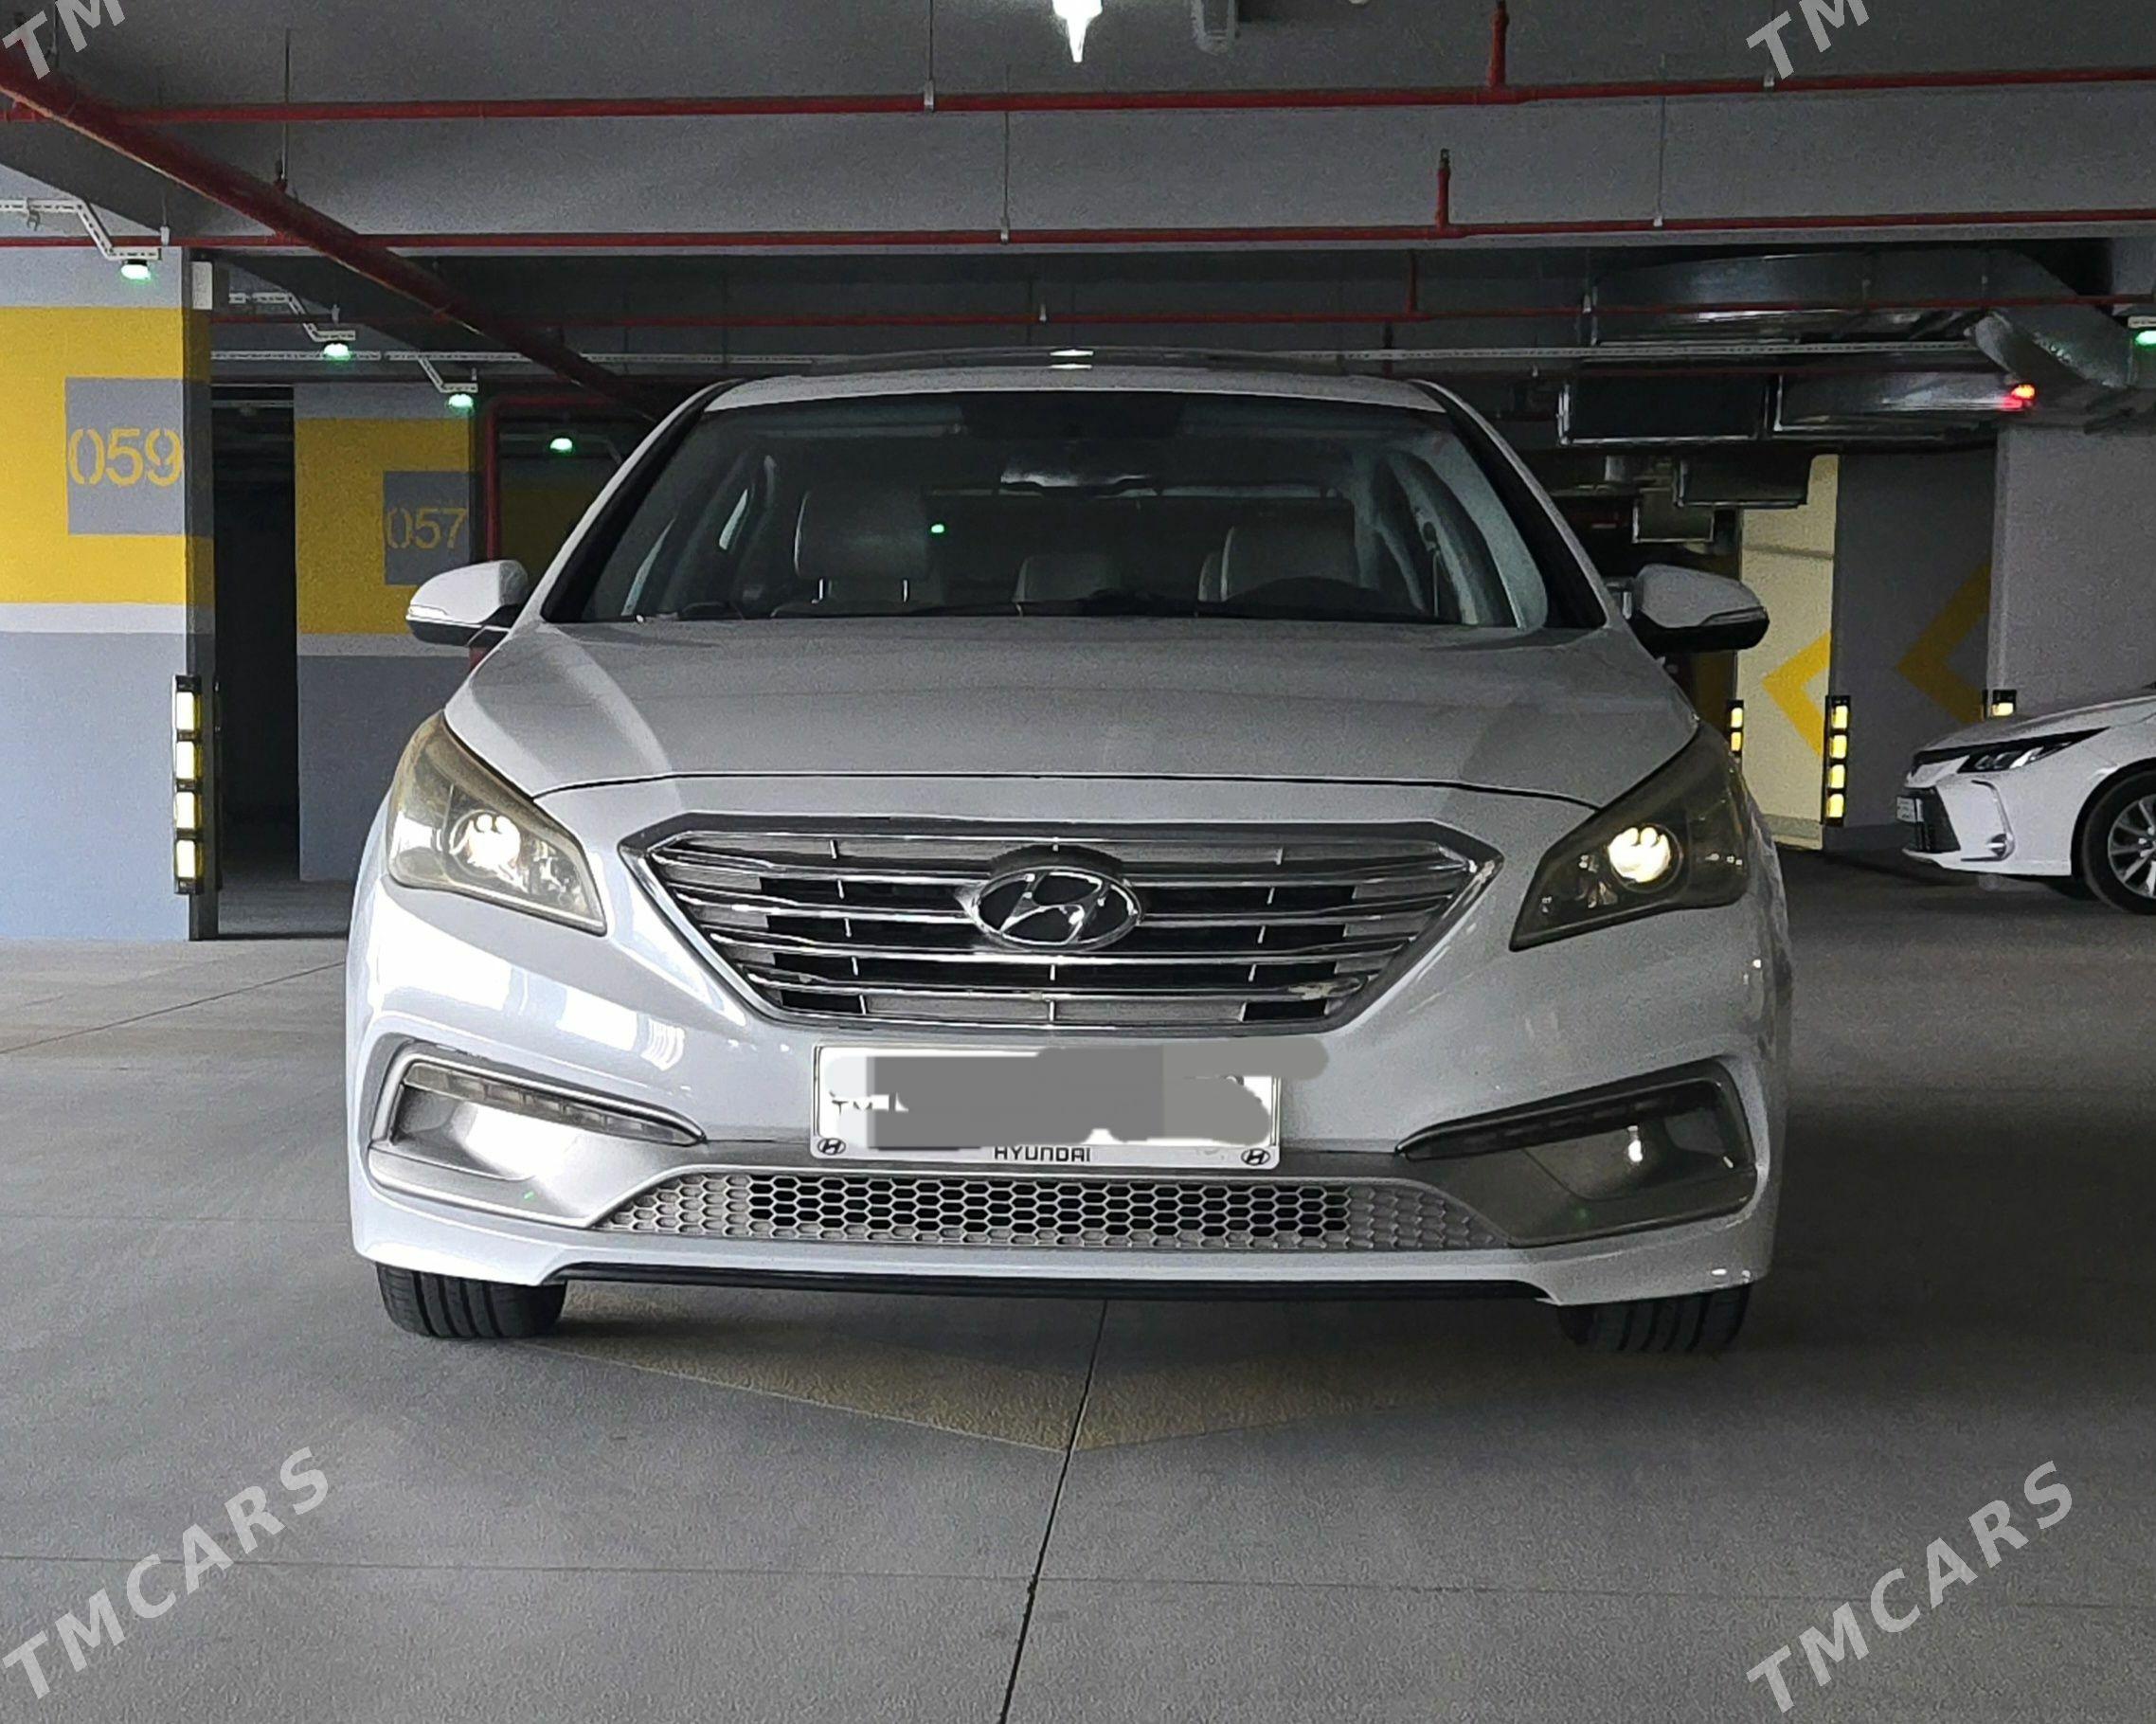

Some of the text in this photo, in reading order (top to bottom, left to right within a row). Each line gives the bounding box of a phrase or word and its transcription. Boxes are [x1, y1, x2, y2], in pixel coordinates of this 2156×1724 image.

[67, 428, 182, 487] 059
[386, 507, 467, 549] 057
[994, 1145, 1091, 1162] HYUNDAI
